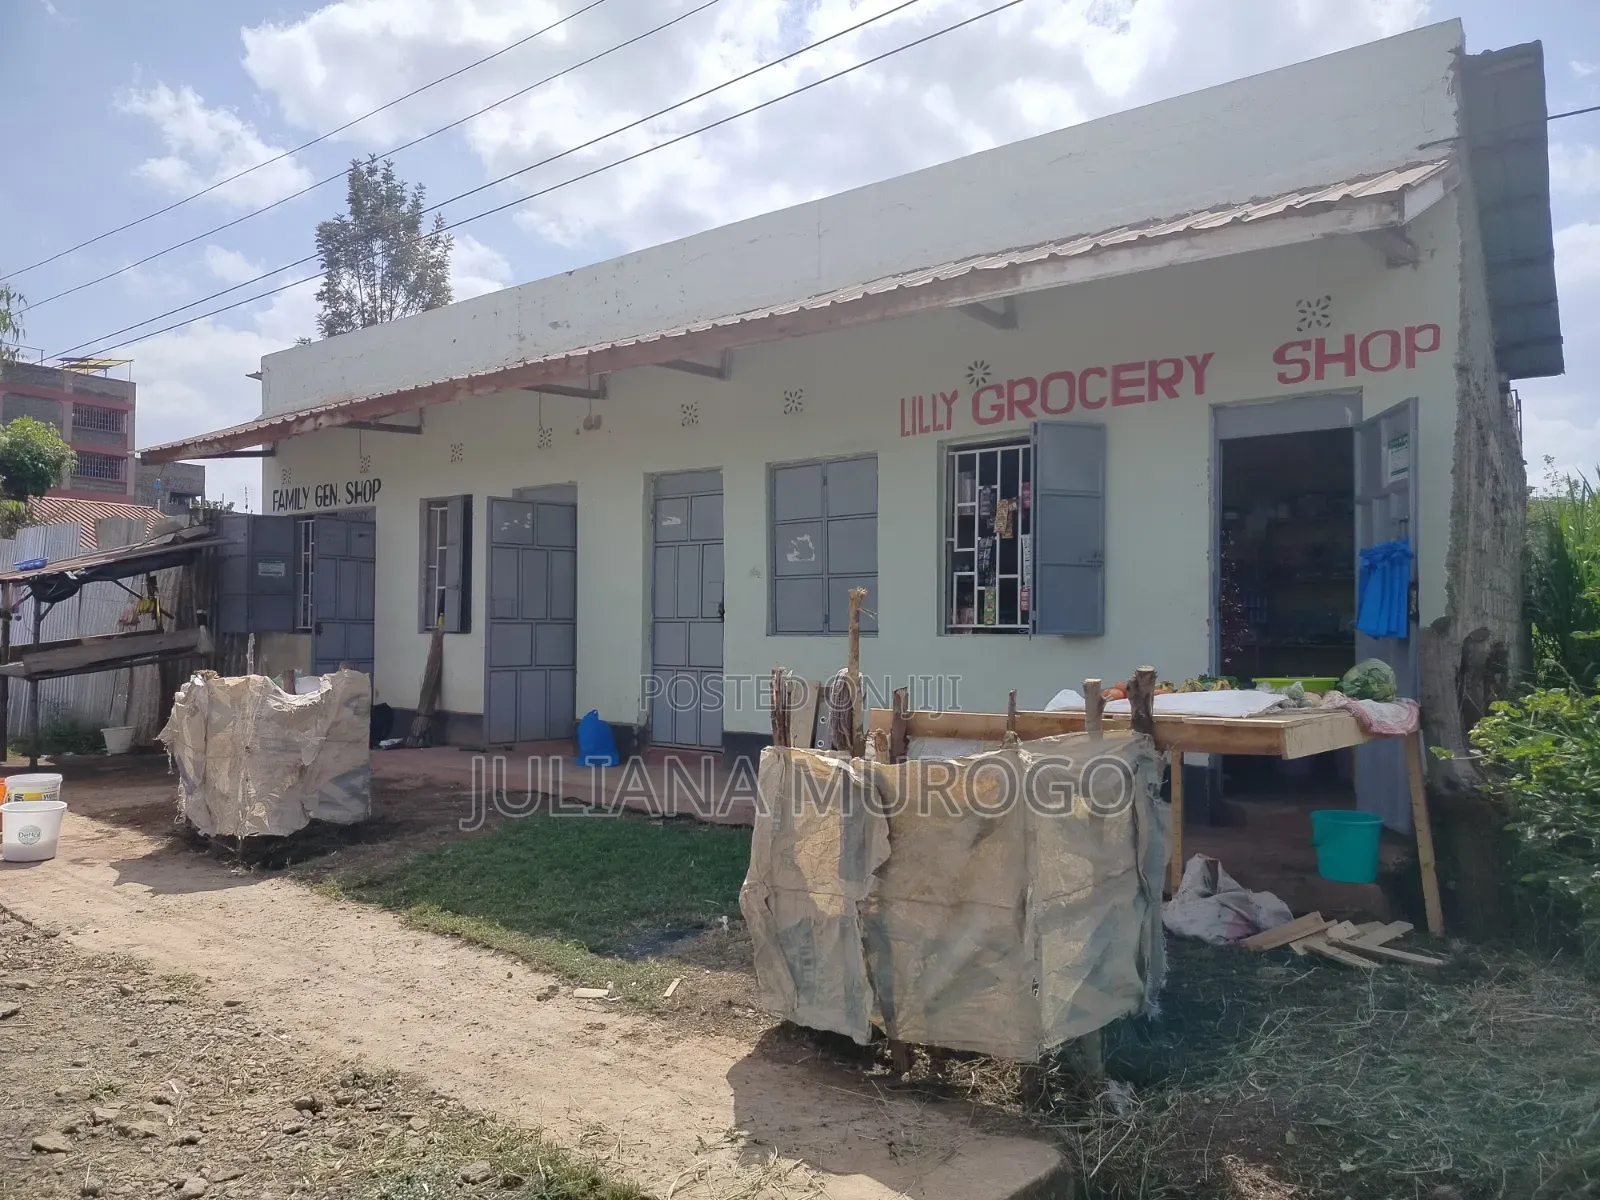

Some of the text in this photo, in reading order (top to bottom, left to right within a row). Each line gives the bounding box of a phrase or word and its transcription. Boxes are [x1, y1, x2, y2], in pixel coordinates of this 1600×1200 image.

[899, 323, 1441, 437] LILLY GROCERY SHOP
[272, 478, 382, 512] FAMILY GEN. SHOP
